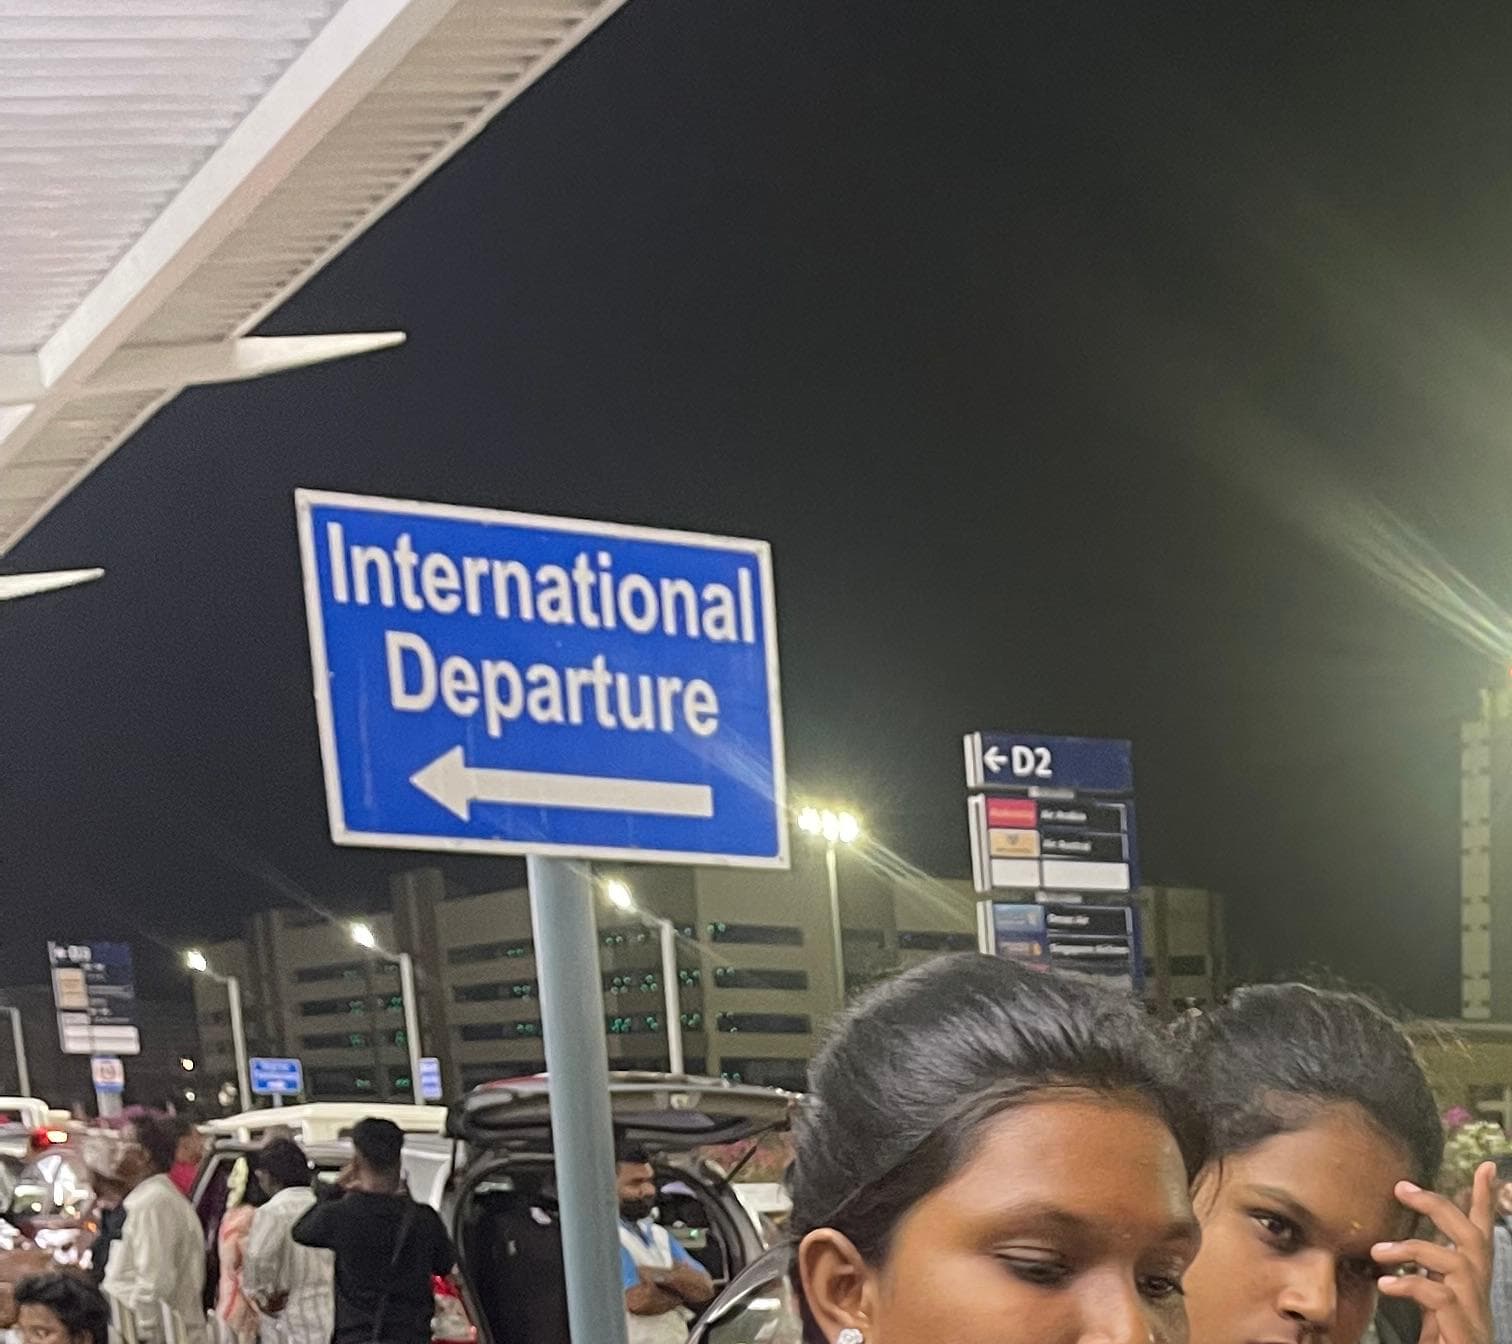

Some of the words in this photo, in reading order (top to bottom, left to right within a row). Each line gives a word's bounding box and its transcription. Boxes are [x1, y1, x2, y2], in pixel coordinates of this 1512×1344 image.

[326, 521, 756, 644] International
[385, 630, 720, 738] Departure
[1011, 745, 1053, 778] D2
